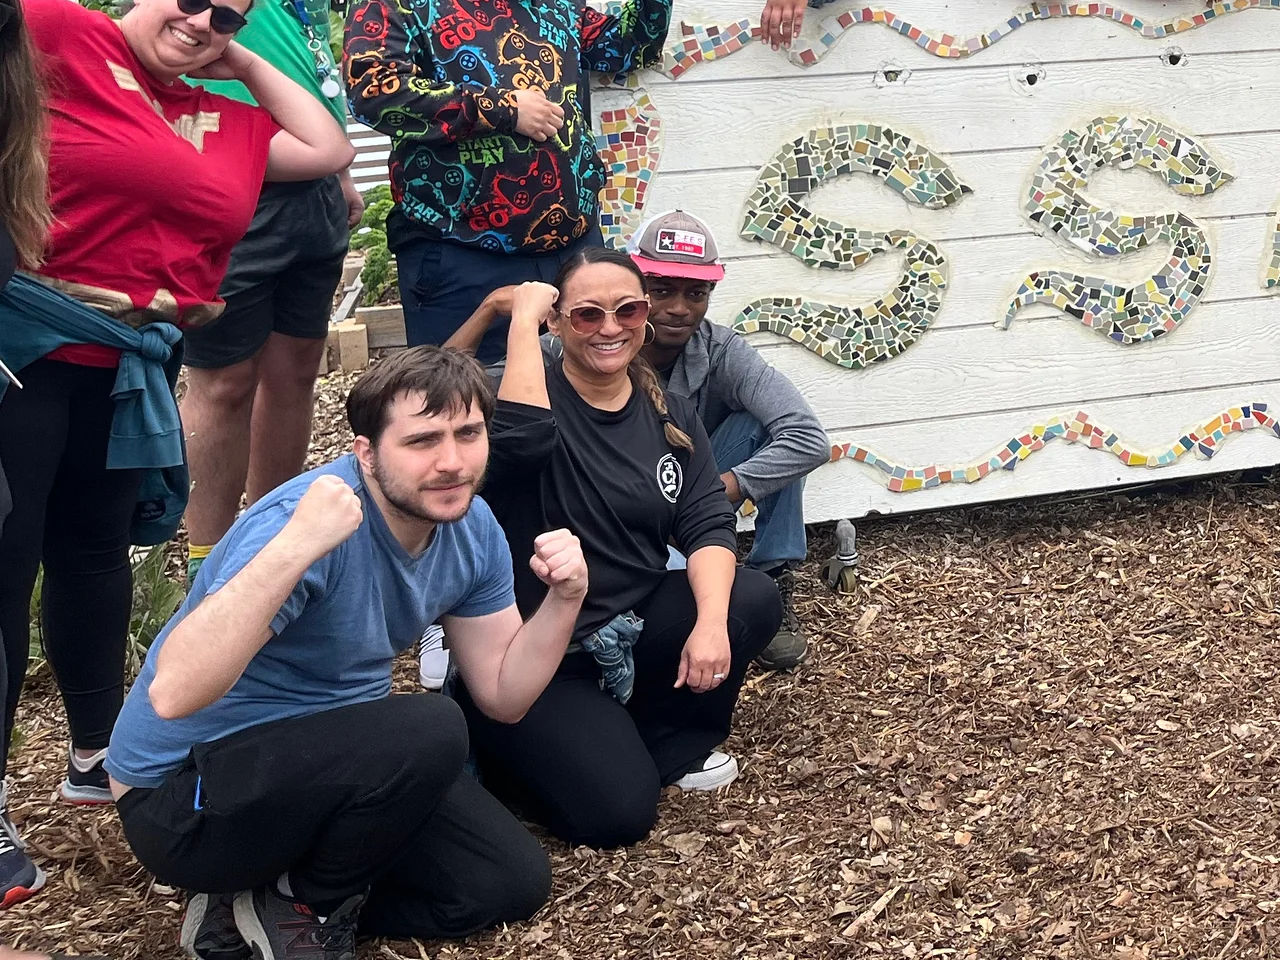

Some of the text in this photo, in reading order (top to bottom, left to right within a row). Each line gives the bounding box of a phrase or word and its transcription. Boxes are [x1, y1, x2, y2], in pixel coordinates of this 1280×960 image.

[439, 21, 476, 50] GO
[361, 74, 401, 99] GO
[457, 135, 502, 151] START
[459, 147, 505, 168] PLAY
[402, 191, 444, 224] START
[468, 208, 510, 232] GO
